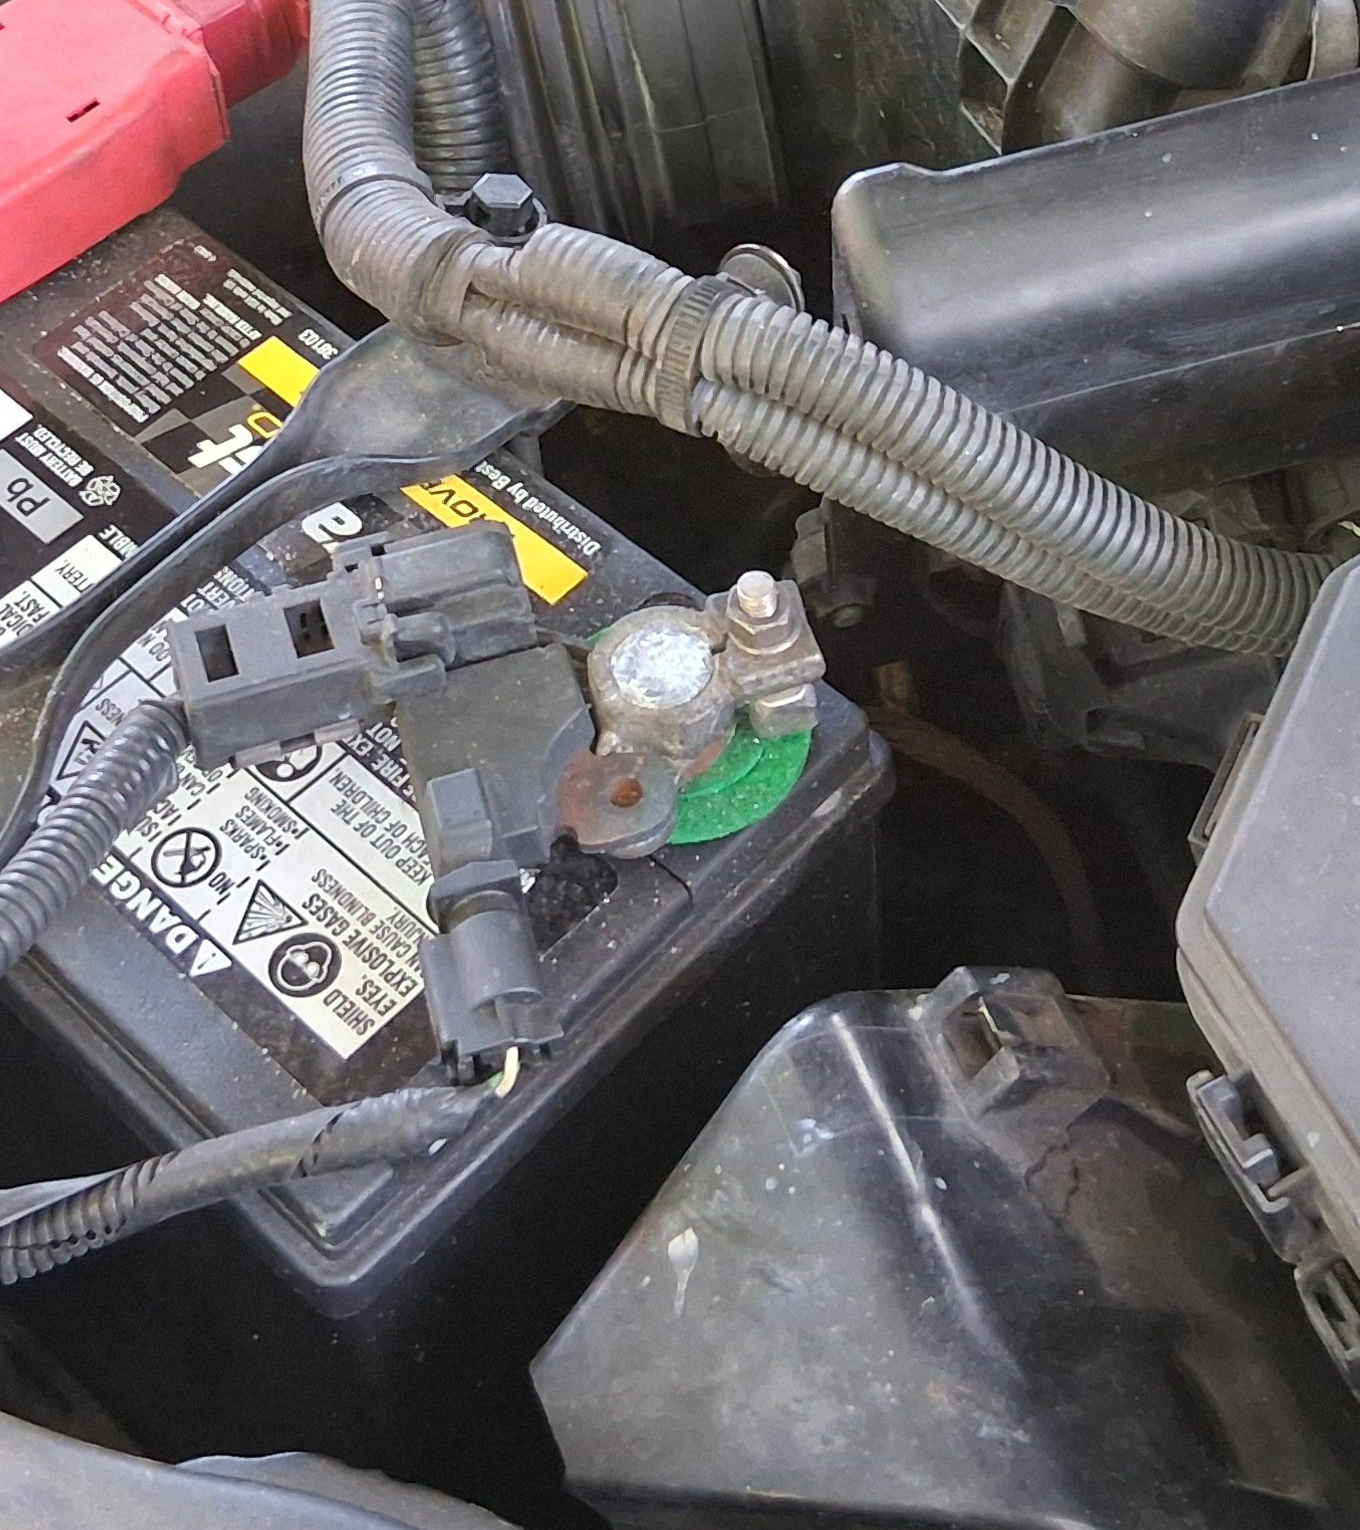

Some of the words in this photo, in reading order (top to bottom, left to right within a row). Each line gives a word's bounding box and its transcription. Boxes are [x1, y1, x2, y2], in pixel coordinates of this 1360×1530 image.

[295, 326, 340, 360] 38103
[12, 430, 48, 458] MUST
[37, 450, 84, 488] BATTERY
[72, 459, 96, 477] BE
[470, 458, 513, 490] Best
[501, 480, 533, 504] by
[519, 496, 603, 556] Distributed
[50, 558, 96, 593] TTERY.
[8, 589, 52, 623] FAST.
[363, 720, 402, 752] NOT
[242, 785, 298, 833] SMOKING
[325, 766, 392, 824] CHILDREN.
[327, 798, 363, 825] THE
[217, 817, 266, 860] SPARKS
[232, 803, 281, 846] FLAMES
[349, 816, 380, 839] OF
[381, 816, 410, 838] OF
[367, 831, 402, 858] OUT
[204, 870, 238, 895] NO
[392, 853, 435, 886] KEEP
[88, 853, 201, 954] DANGE
[299, 891, 353, 937] GASES
[308, 866, 378, 926] BLINDNESS
[368, 919, 413, 959] CAUSE
[384, 905, 429, 948] NJURY.
[340, 927, 420, 998] EXPLOSIVE
[320, 987, 377, 1037] SHIELD
[351, 972, 397, 1017] EYES.
